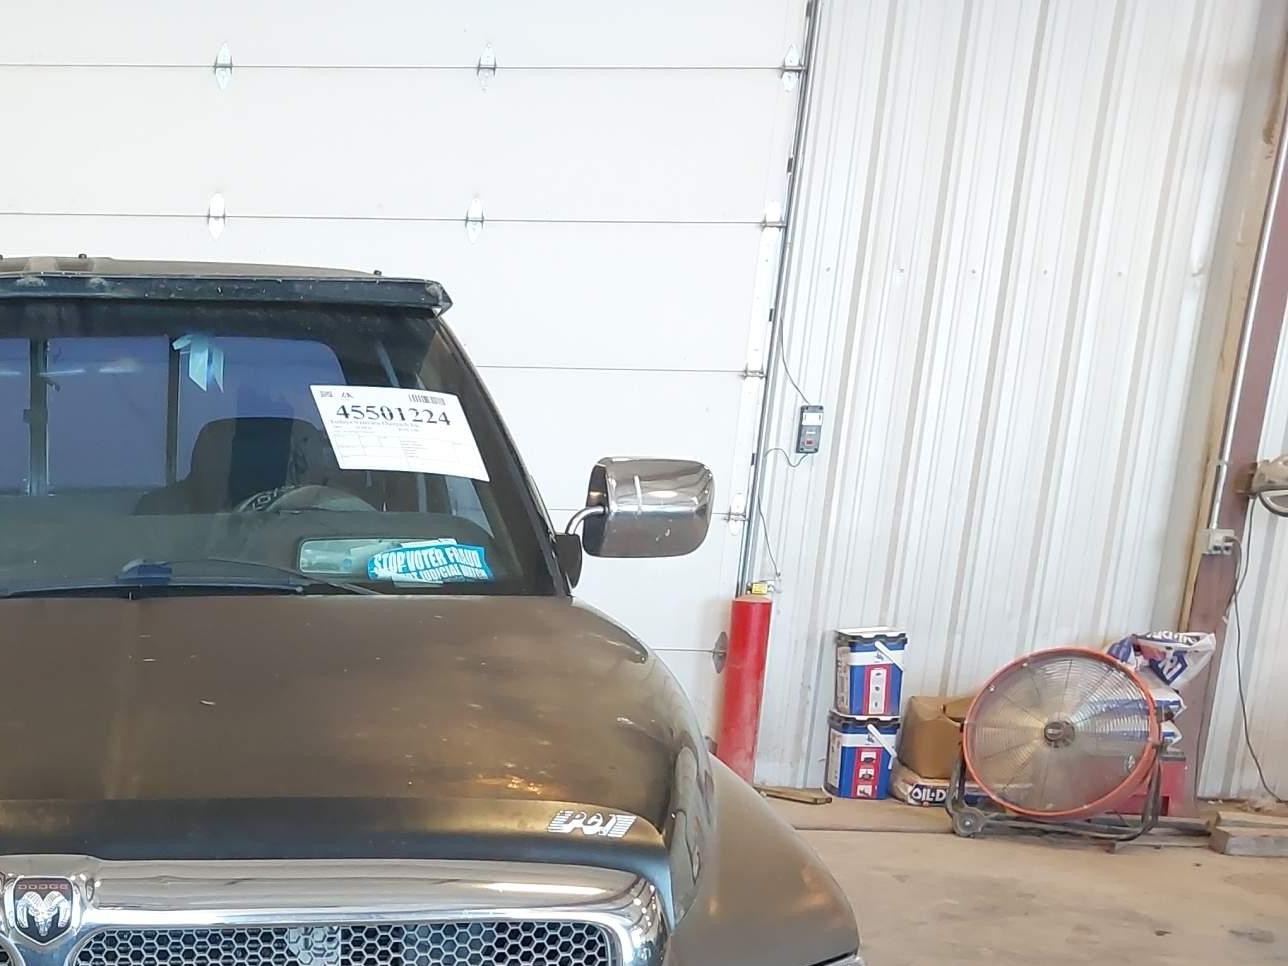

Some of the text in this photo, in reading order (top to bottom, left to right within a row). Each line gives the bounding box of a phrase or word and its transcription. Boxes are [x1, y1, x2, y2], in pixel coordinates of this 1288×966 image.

[336, 404, 451, 426] 45501224
[373, 546, 483, 574] STOP VOTER FRAUD
